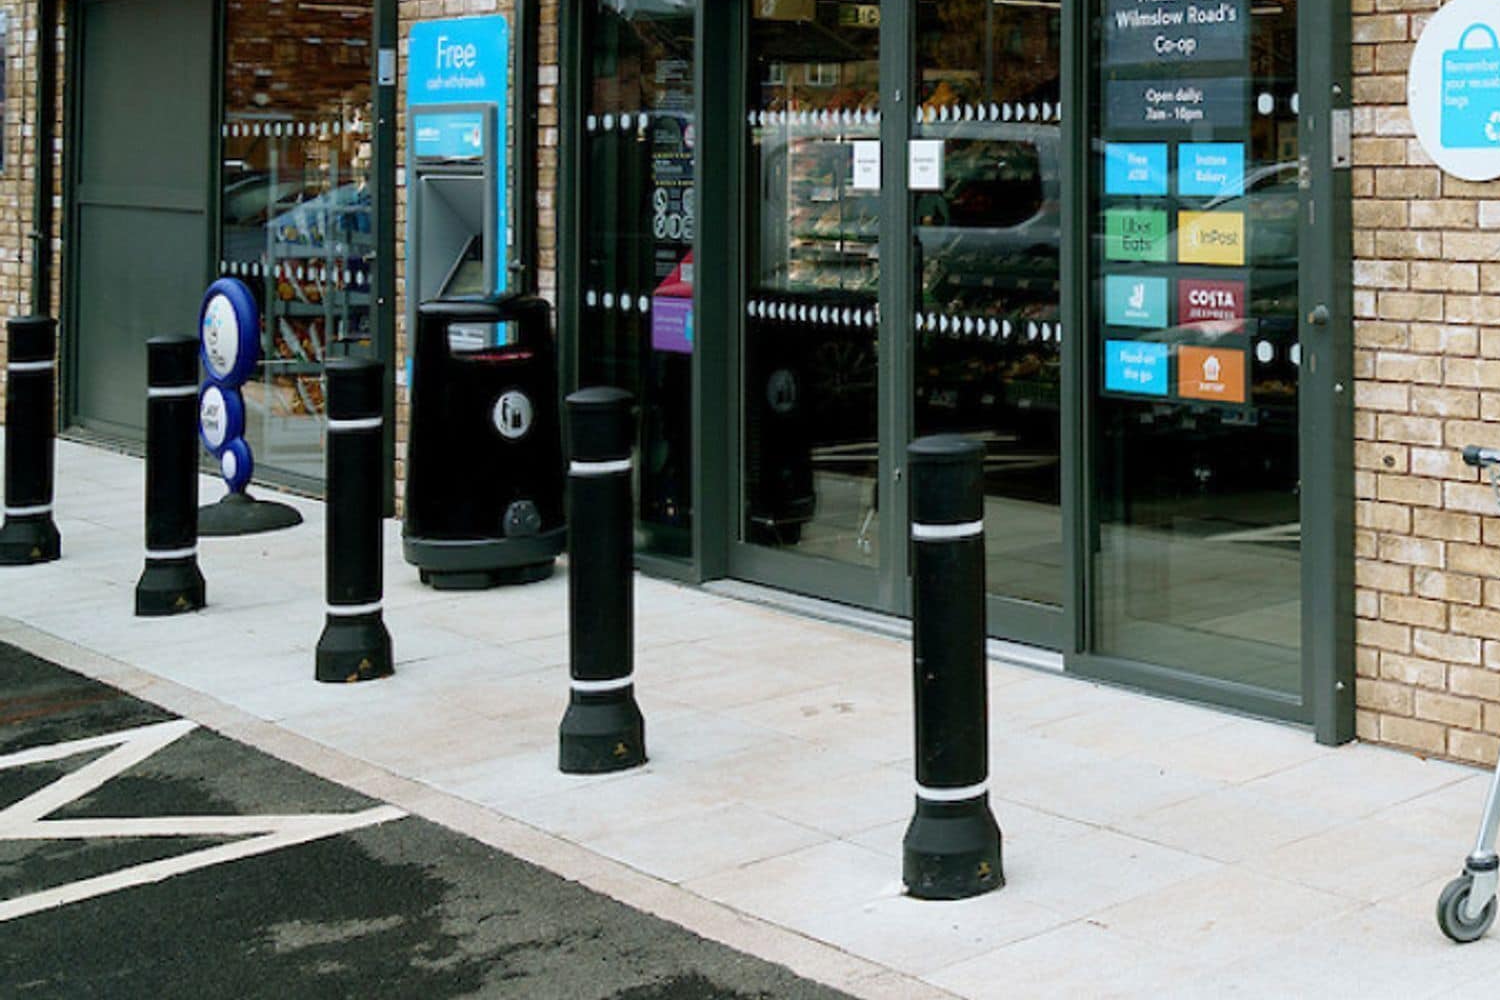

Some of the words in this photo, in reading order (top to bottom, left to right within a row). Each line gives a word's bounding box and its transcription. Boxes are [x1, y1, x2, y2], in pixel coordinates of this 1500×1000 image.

[1115, 7, 1183, 28] Wilmslow
[1187, 3, 1236, 23] Road's
[436, 35, 477, 70] Free
[1153, 35, 1197, 56] Co-op
[1145, 88, 1174, 104] Open
[1122, 216, 1152, 233] Uber
[1122, 234, 1152, 251] Eats
[1199, 230, 1239, 247] InPost
[1189, 289, 1235, 307] COSTA
